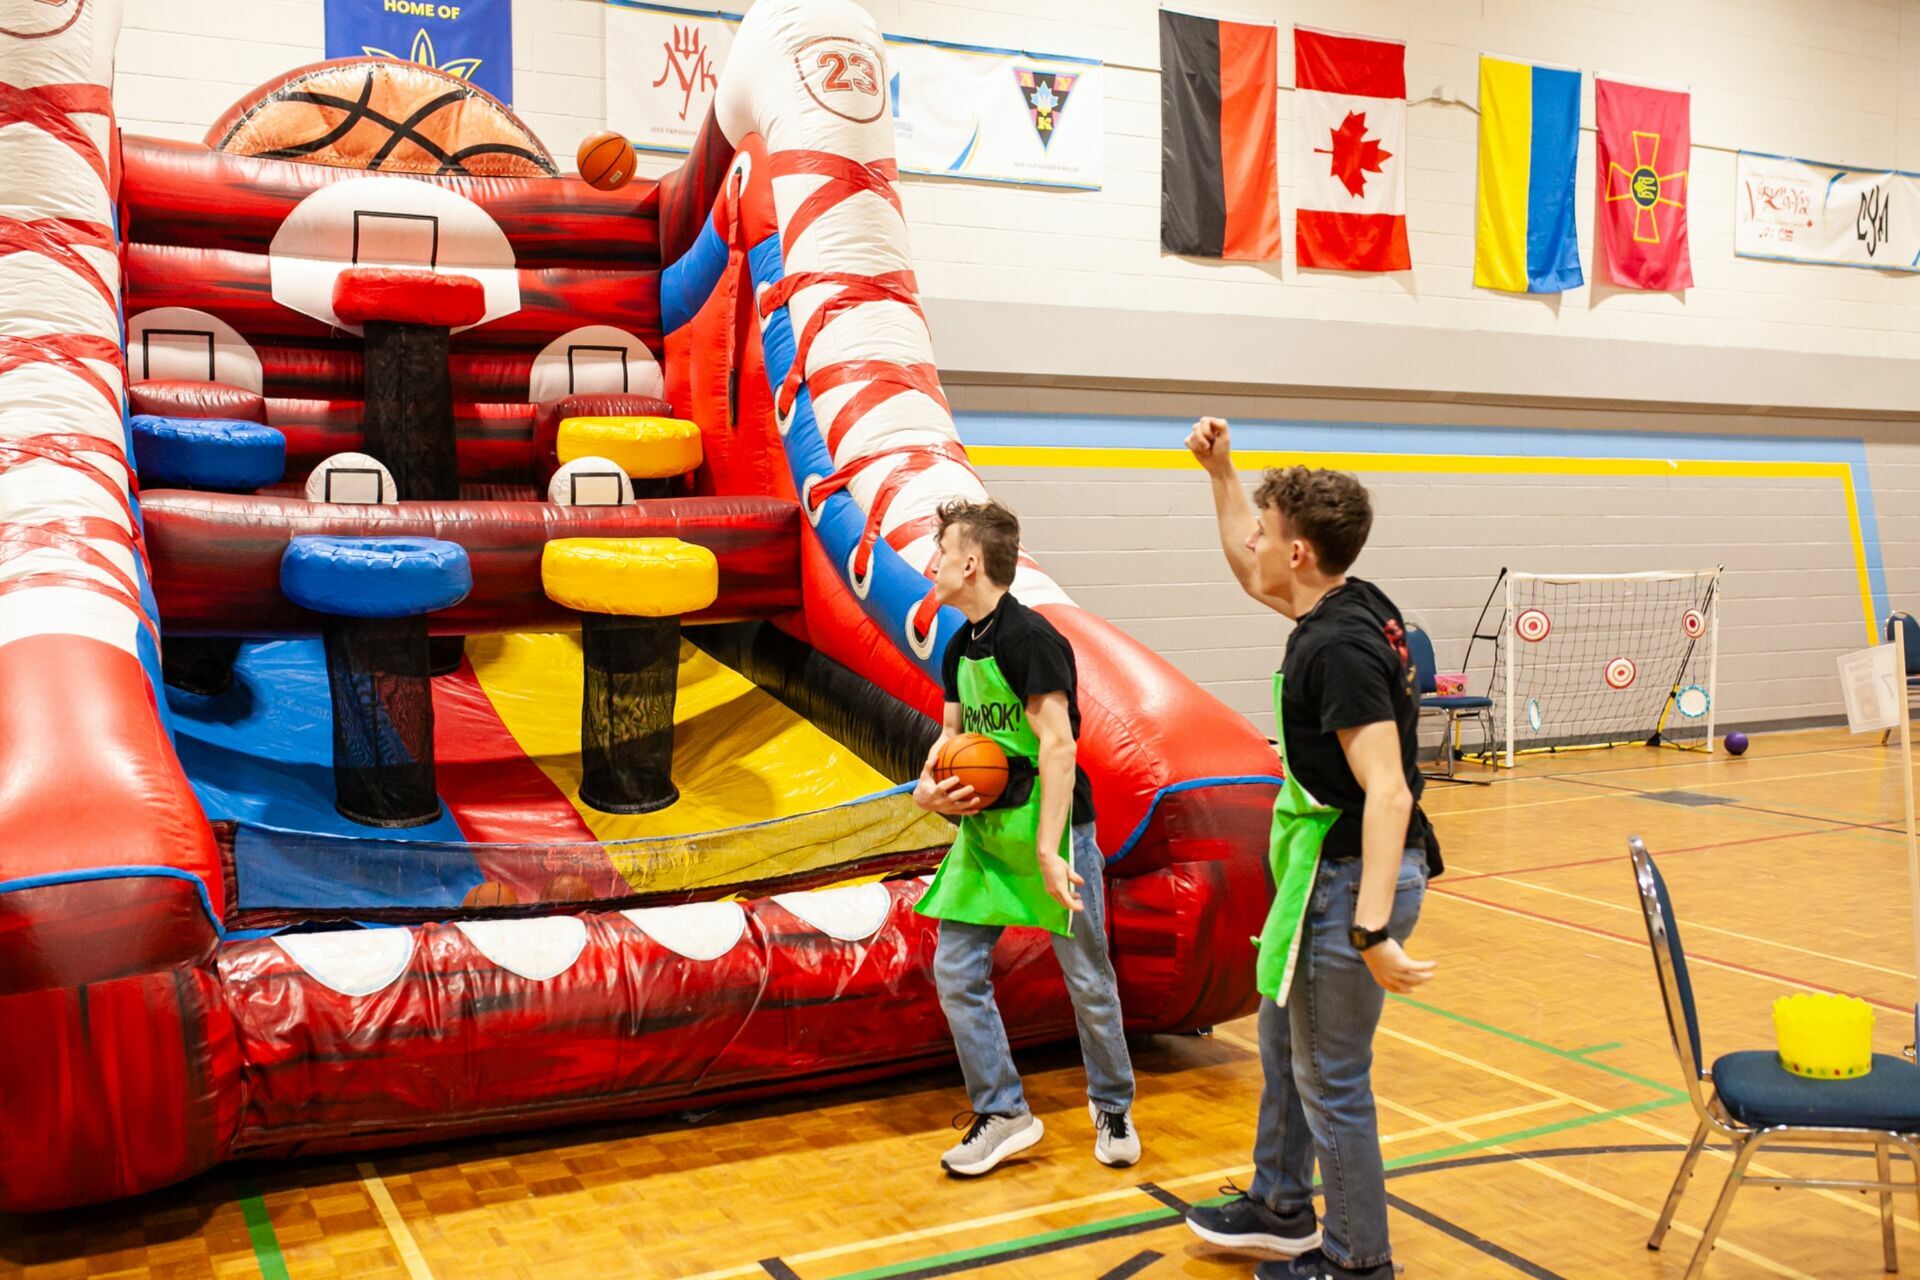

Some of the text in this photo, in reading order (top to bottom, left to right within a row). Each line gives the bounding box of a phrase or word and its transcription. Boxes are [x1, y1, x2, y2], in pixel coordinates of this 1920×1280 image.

[384, 0, 460, 19] HOME OF
[817, 51, 879, 96] 23
